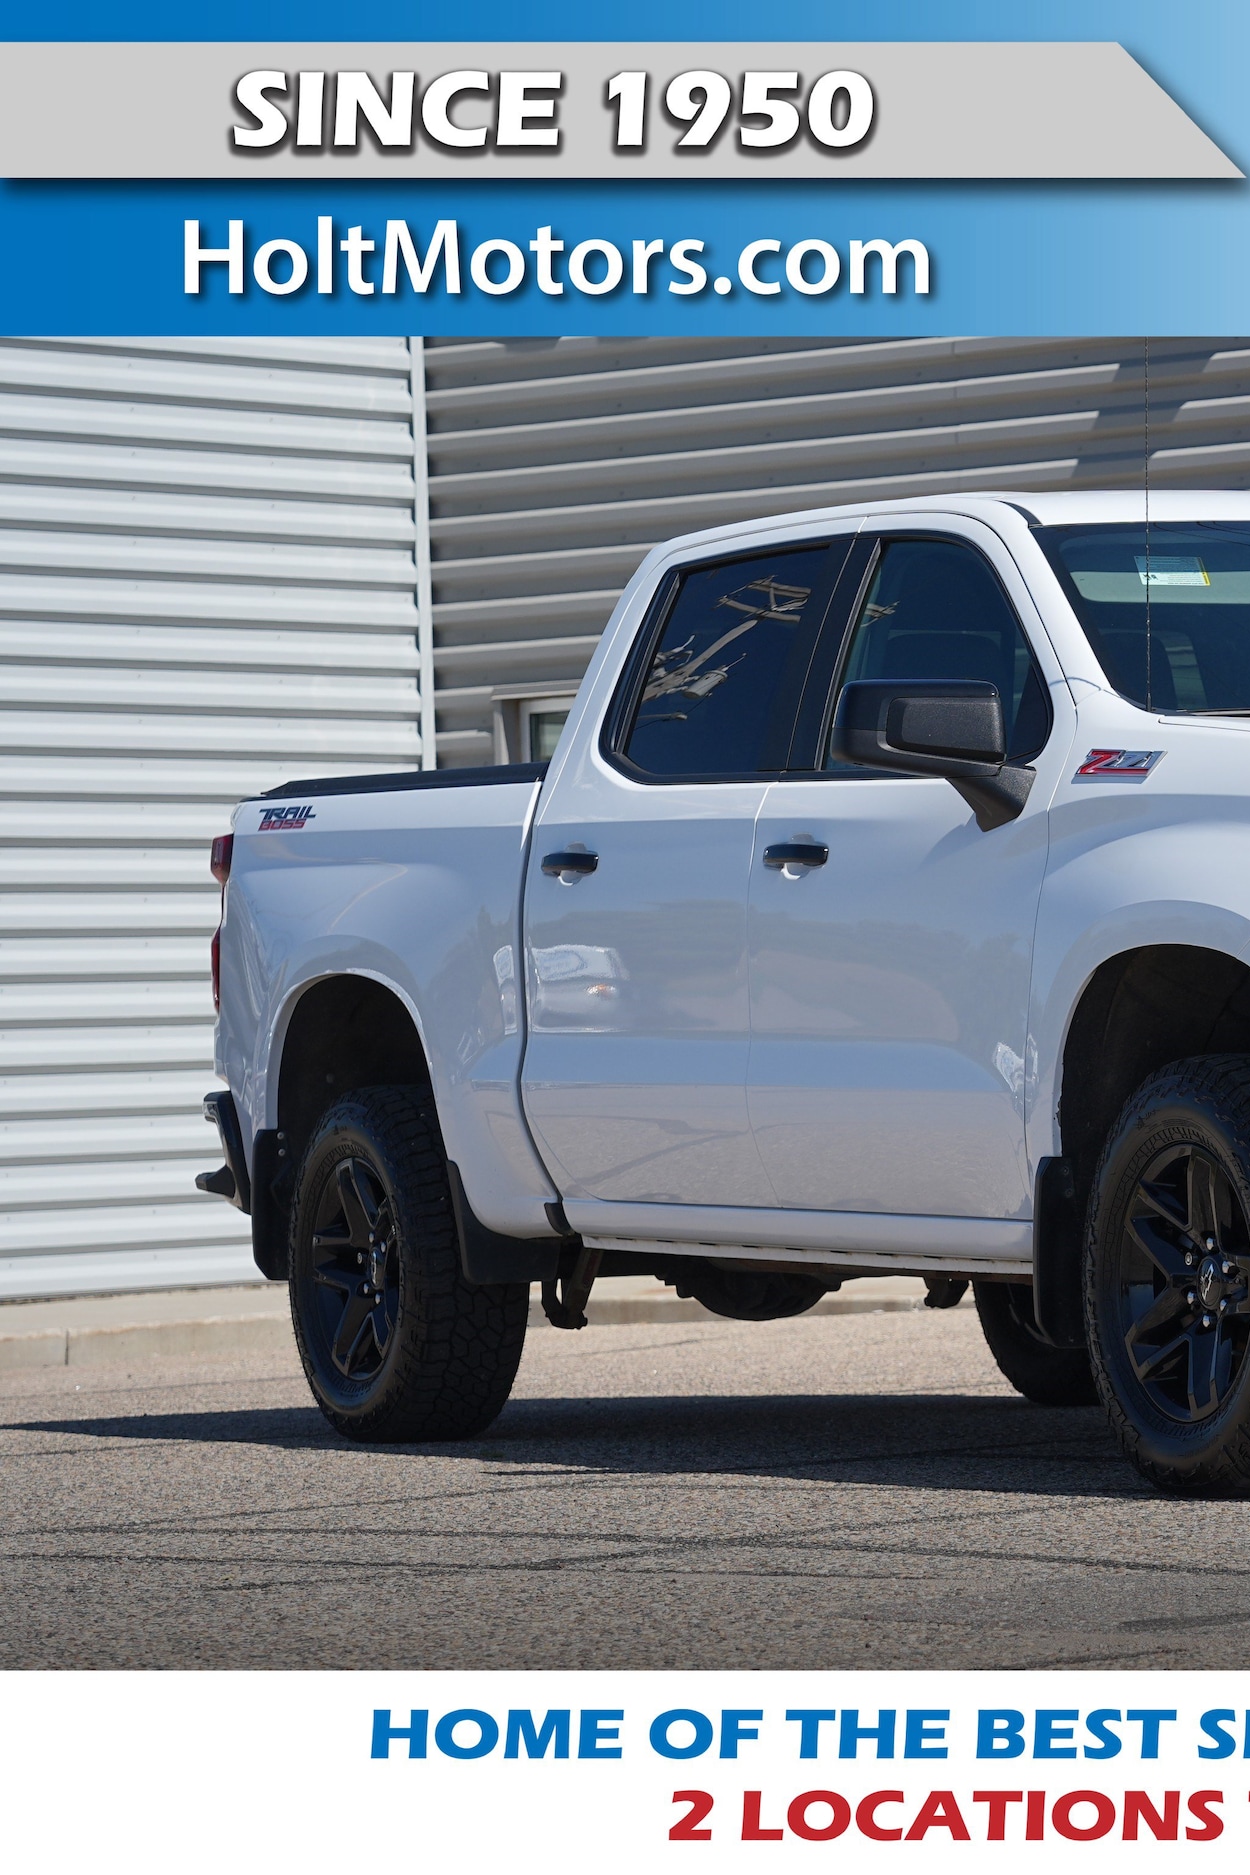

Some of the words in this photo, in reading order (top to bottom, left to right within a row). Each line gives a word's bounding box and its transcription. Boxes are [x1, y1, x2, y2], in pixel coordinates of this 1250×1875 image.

[1076, 749, 1167, 776] Z71
[259, 805, 317, 820] TRAIL
[258, 818, 307, 831] BOSS
